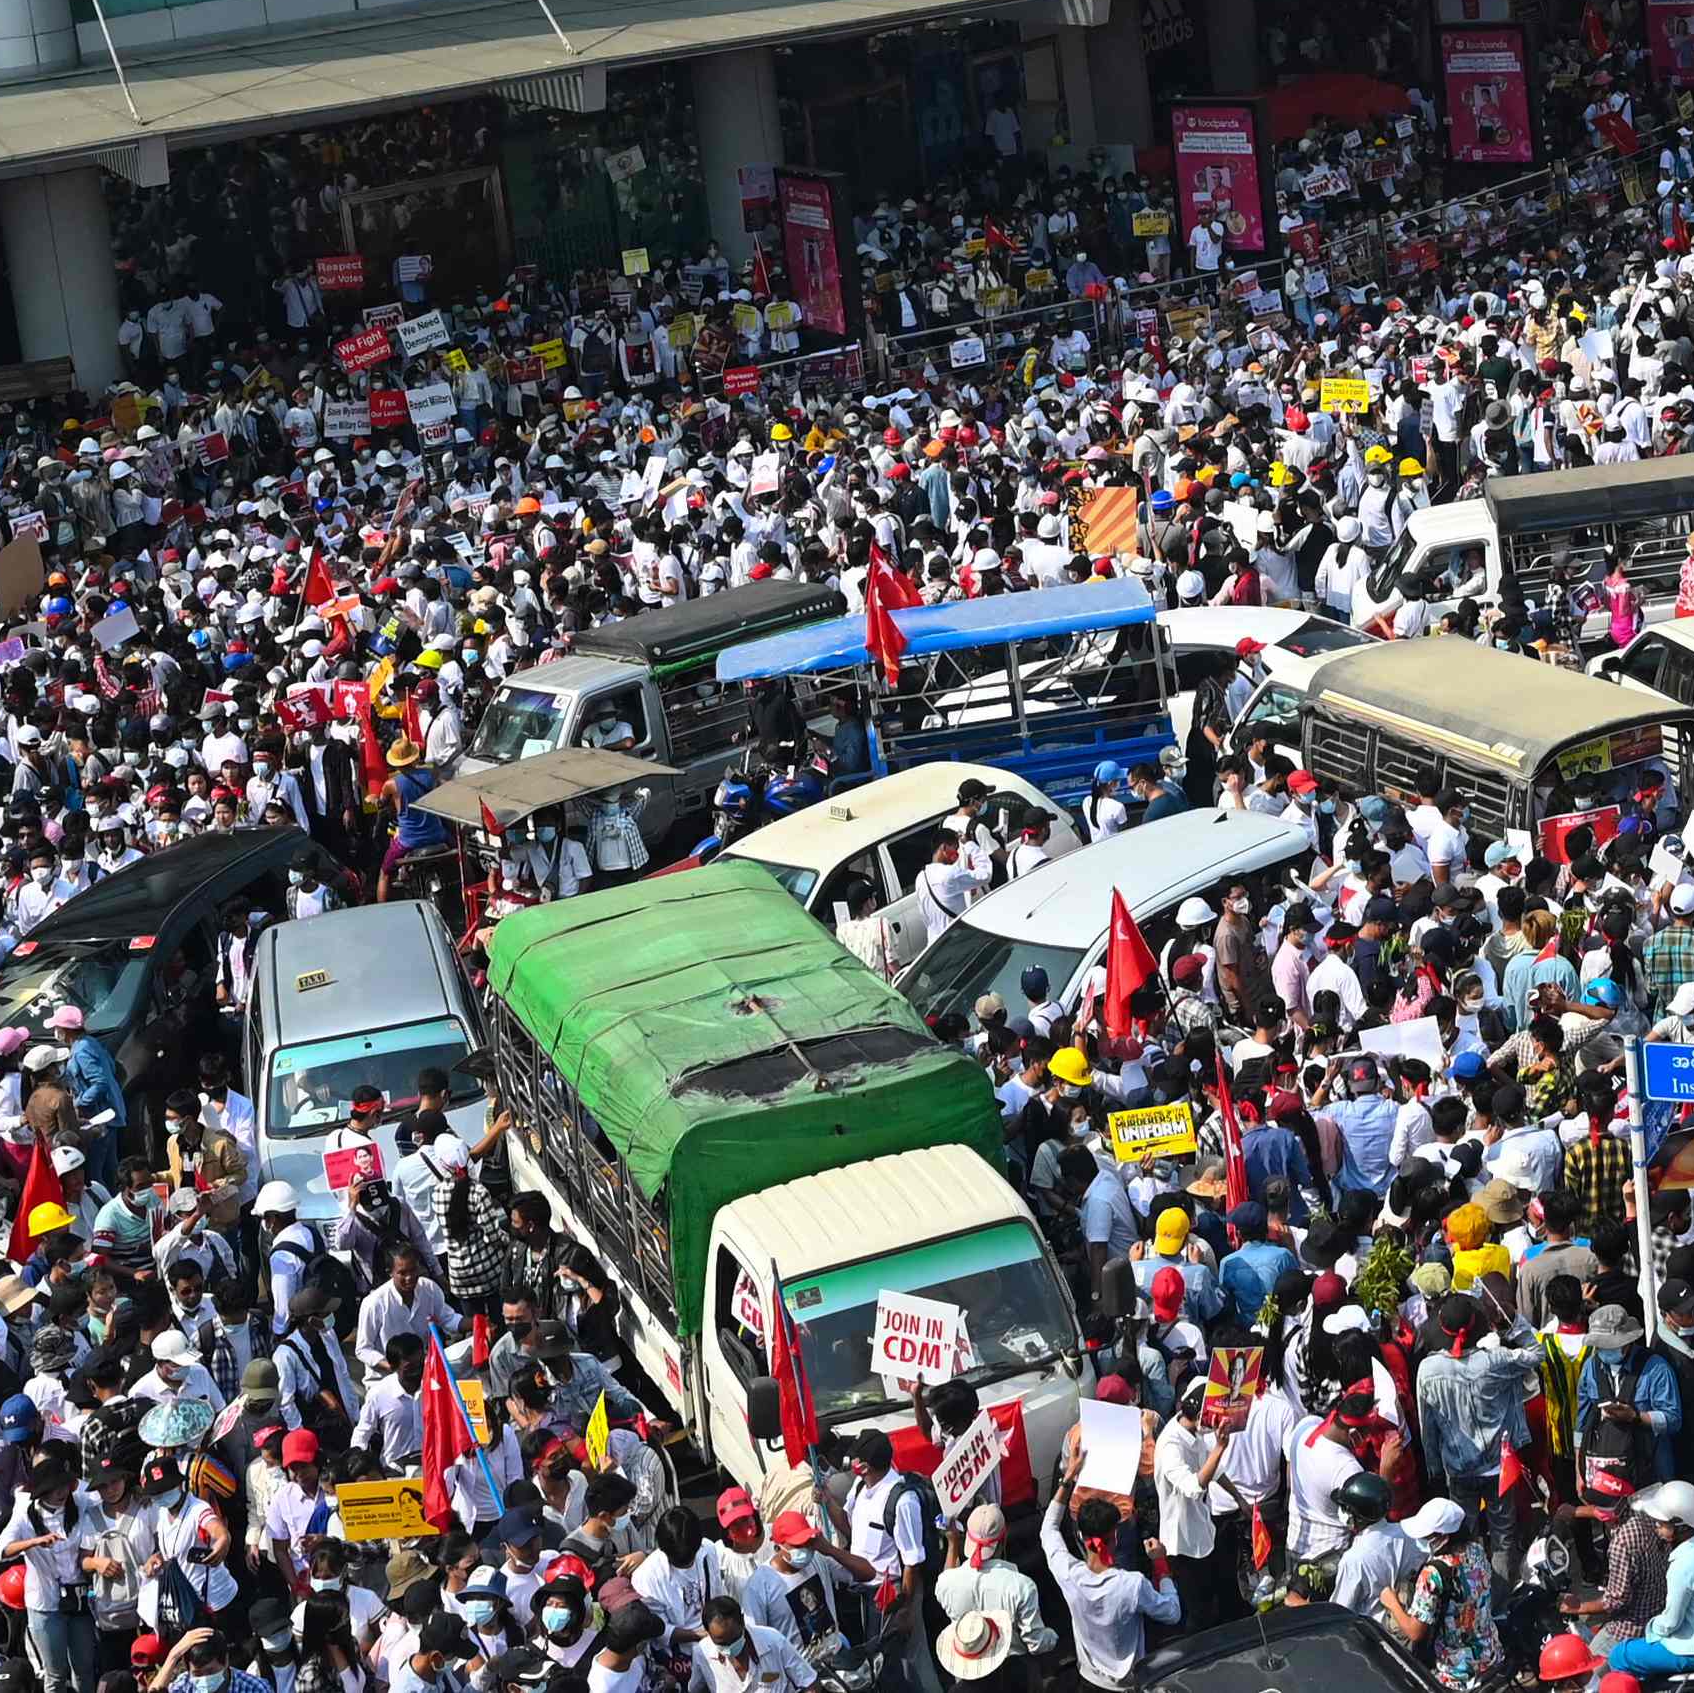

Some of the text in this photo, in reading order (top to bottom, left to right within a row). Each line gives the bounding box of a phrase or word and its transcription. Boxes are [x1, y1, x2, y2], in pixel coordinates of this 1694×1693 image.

[1197, 117, 1239, 130] foodpanda
[317, 259, 363, 273] Respect
[318, 274, 364, 285] Our Votes
[401, 316, 440, 337] We Need
[338, 330, 384, 356] We Fight
[404, 330, 447, 349] Democracy
[425, 426, 447, 440] CDM
[298, 972, 326, 989] TAXI
[925, 1318, 944, 1341] IN
[970, 1429, 985, 1451] IN
